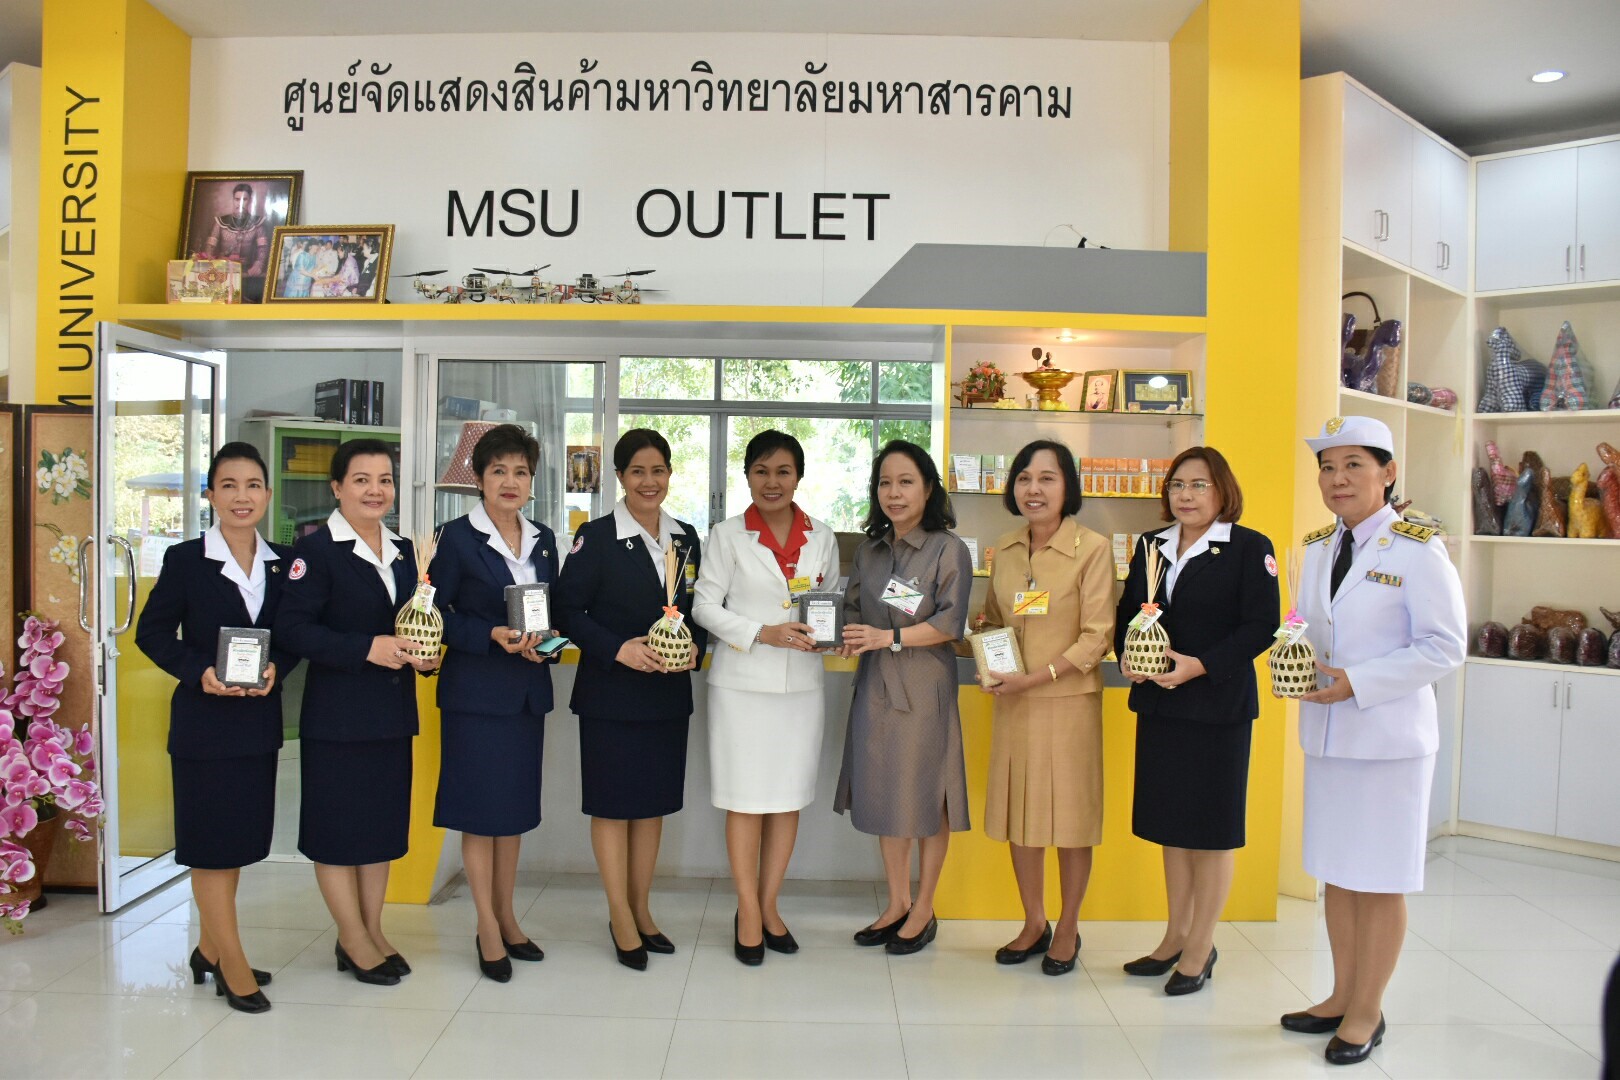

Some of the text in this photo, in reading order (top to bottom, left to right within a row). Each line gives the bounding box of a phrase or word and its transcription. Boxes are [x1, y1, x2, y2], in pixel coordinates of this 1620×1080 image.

[285, 59, 1072, 131] ศูนย์จัดแสดงสินค้ามหาวิทยาลัยมหาสารคาม
[58, 85, 101, 372] UNIVERSITY
[447, 188, 890, 241] MSU OUTLET
